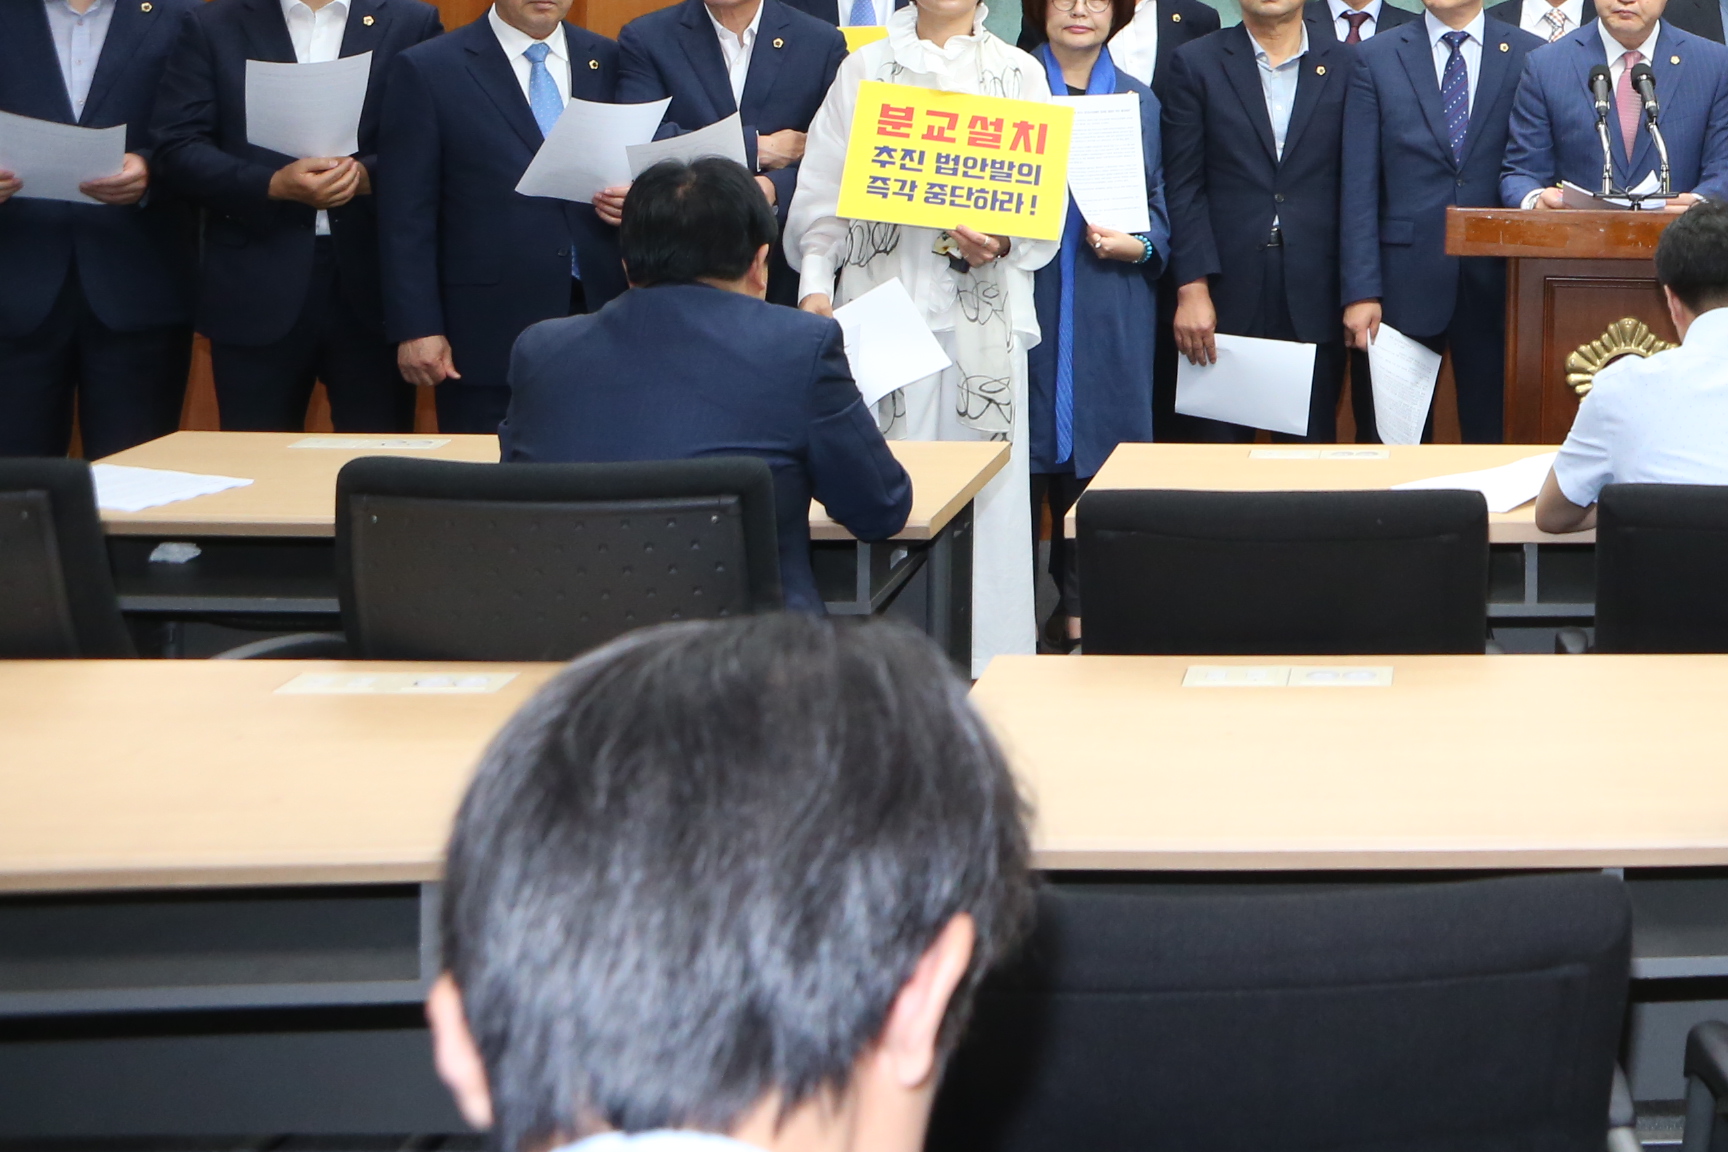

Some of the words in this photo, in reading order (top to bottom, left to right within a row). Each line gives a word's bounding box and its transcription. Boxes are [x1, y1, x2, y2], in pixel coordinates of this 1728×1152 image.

[877, 104, 1047, 154] 분교설치
[872, 146, 925, 172] 추진
[935, 153, 1041, 185] 법안발의
[867, 176, 917, 201] 즉각
[924, 183, 1037, 215] 중단하라!
